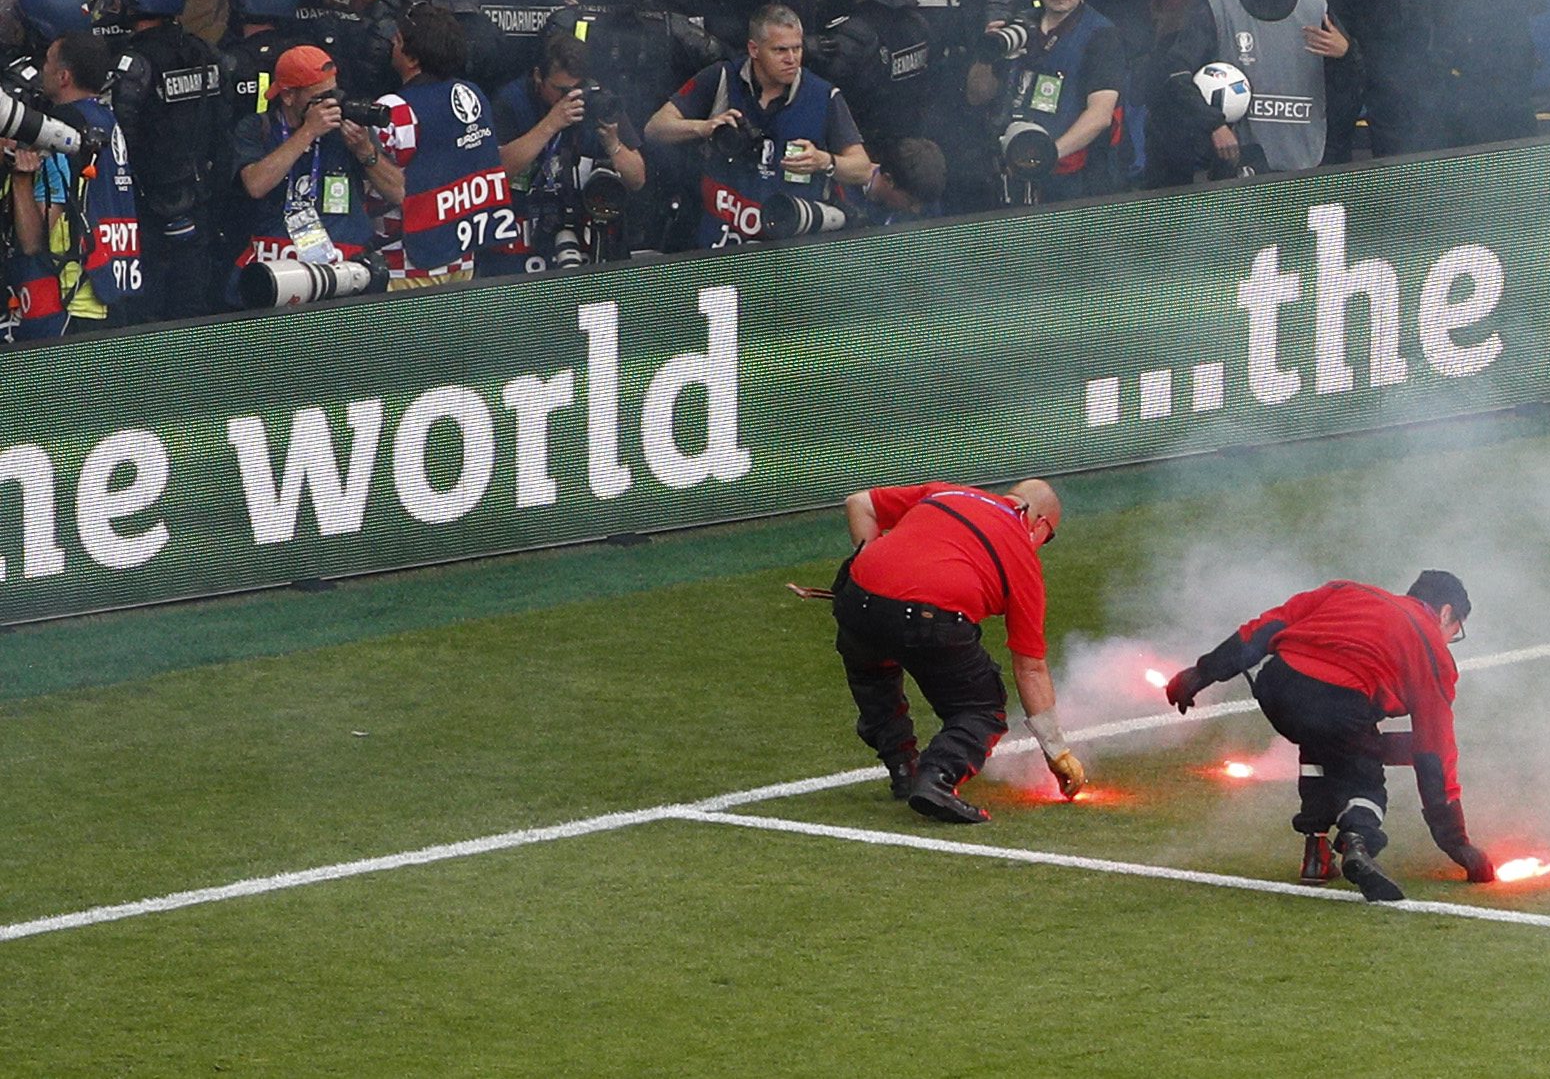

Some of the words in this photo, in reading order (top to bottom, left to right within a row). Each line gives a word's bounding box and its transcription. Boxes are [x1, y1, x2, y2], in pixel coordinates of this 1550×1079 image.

[1250, 100, 1313, 118] ESPECT
[436, 171, 506, 221] PHOT
[457, 208, 518, 252] 972
[113, 258, 142, 291] 916
[228, 286, 753, 545] world
